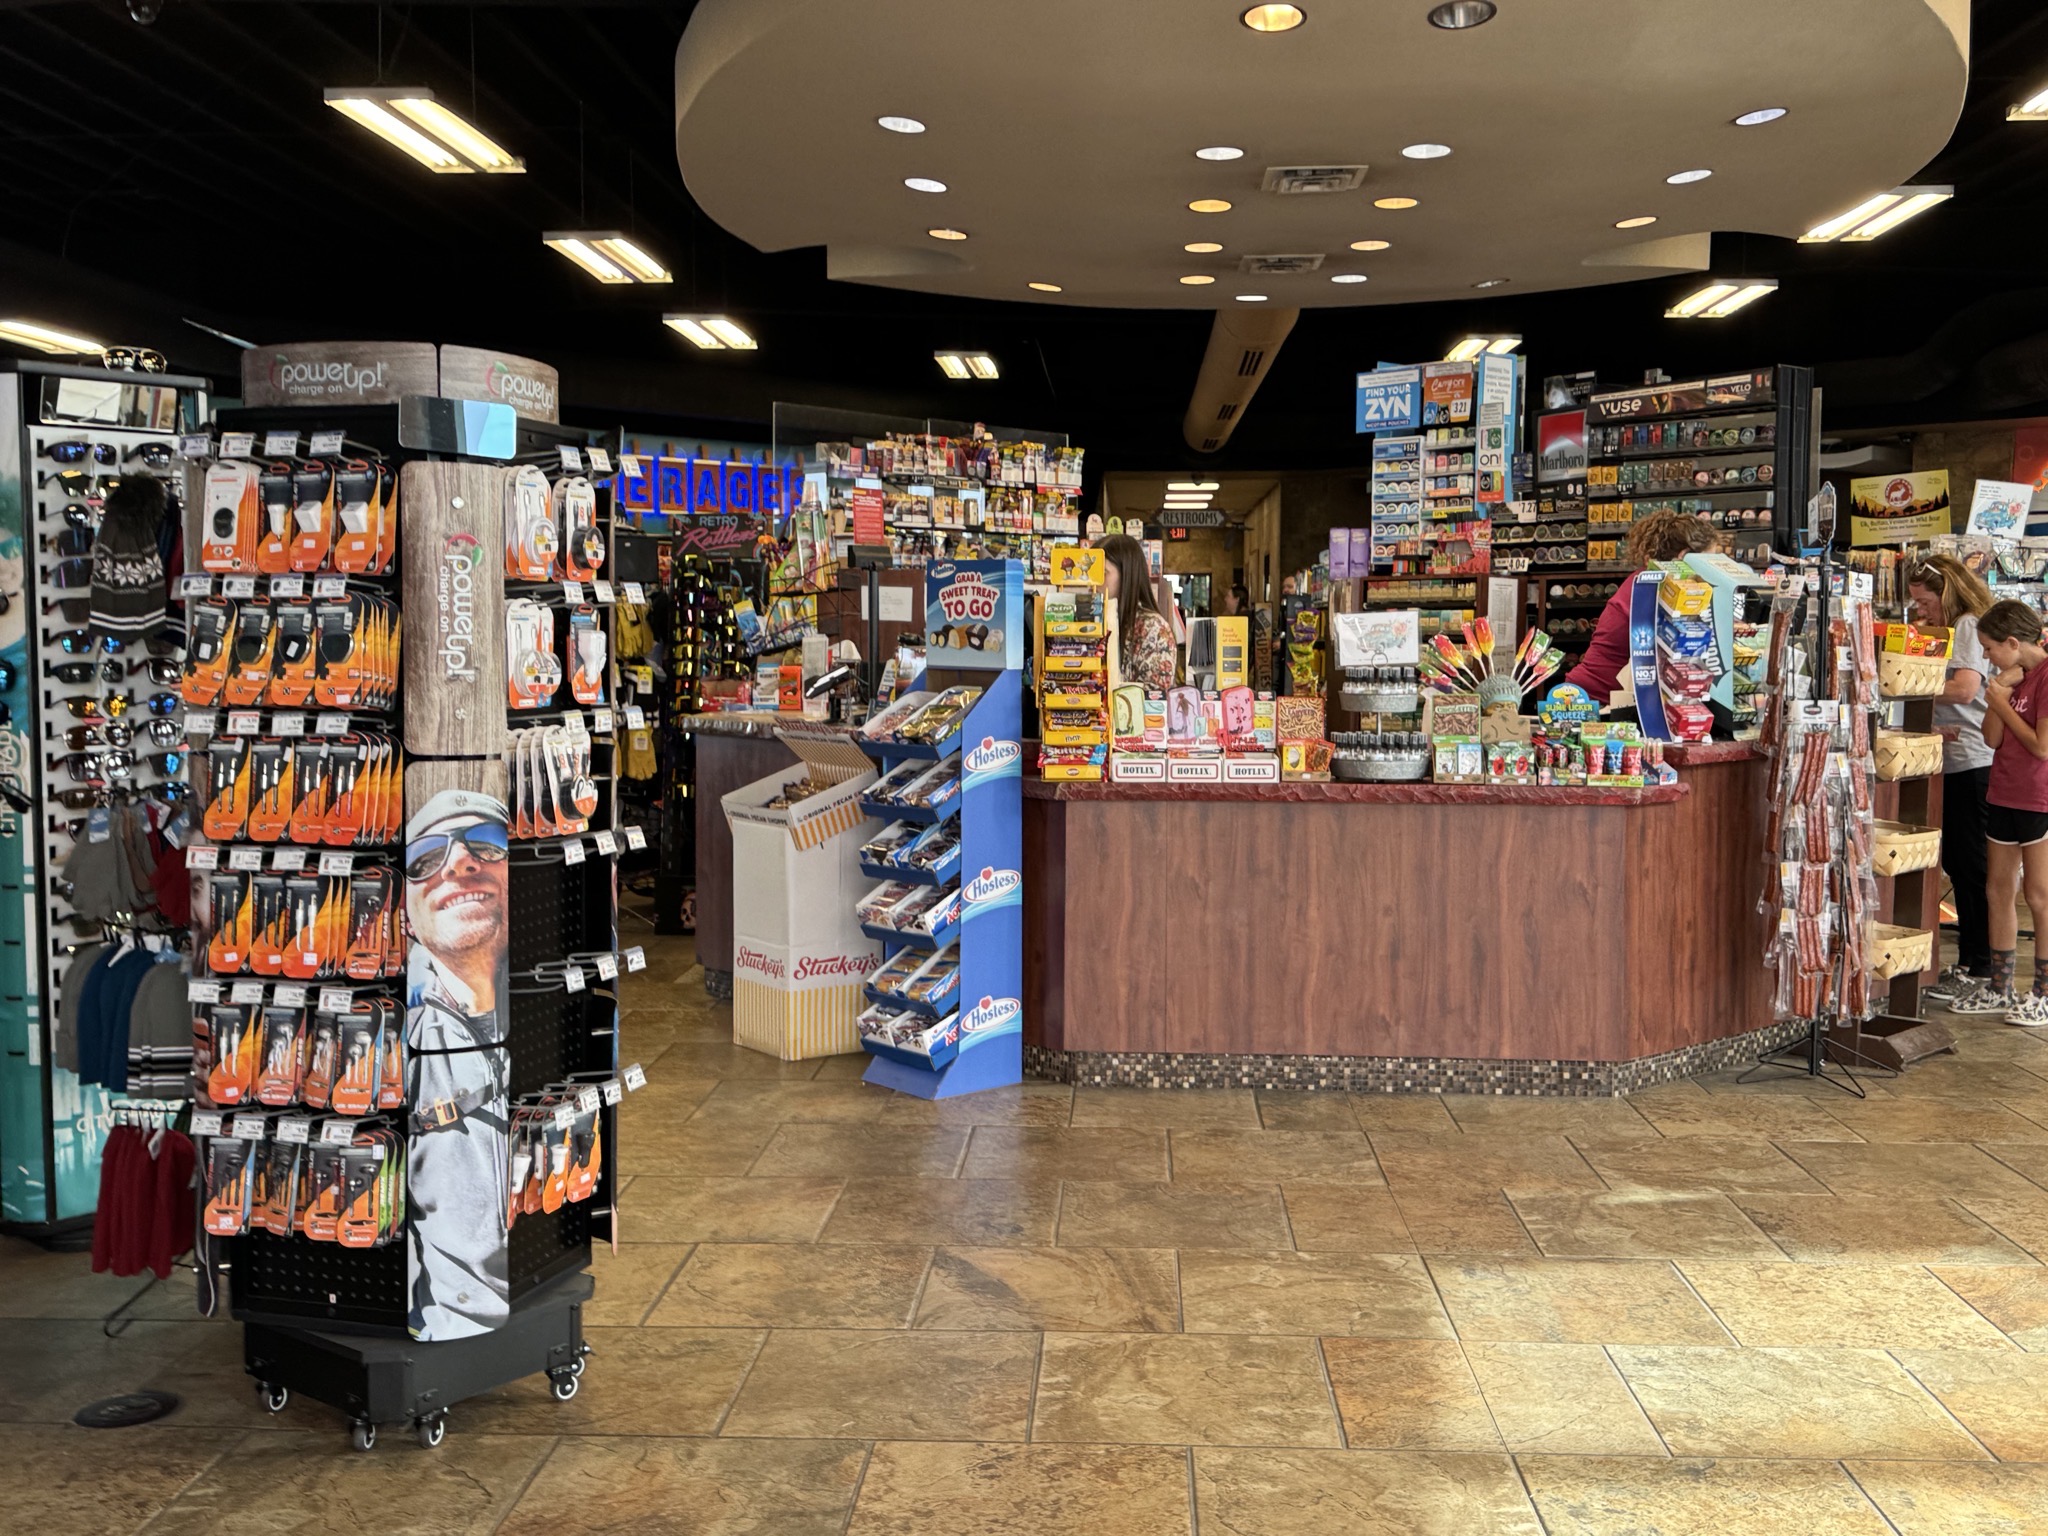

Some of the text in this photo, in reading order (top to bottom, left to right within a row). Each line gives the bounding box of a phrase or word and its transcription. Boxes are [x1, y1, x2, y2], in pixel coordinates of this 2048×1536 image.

[289, 383, 343, 396] charge on
[1365, 383, 1411, 399] FIND YOUR
[1730, 383, 1752, 393] VELO
[508, 396, 533, 409] charge
[1364, 393, 1412, 421] ZYN
[1540, 449, 1585, 472] Marlboro
[699, 515, 739, 527] RETRO
[1163, 511, 1218, 525] RESTROOMS
[956, 573, 981, 582] GRAB A
[438, 566, 450, 633] charge on
[941, 586, 998, 601] SWEET TREAT
[944, 599, 993, 618] TO GO
[1255, 628, 1272, 690] SUPPLIES
[1545, 703, 1593, 712] SLIME LICKER
[1552, 710, 1587, 721] SQUEEZE
[973, 744, 1016, 769] Hostess
[1047, 747, 1090, 756] Skittles
[1122, 766, 1155, 775] HOTLIX
[1177, 767, 1209, 776] HOTLIX
[1234, 767, 1268, 776] HOTLIX
[803, 804, 831, 821] ORIGINAL
[832, 794, 854, 809] PECAN
[750, 813, 767, 822] PECAN
[767, 816, 788, 826] SHOPPE
[973, 874, 1016, 899] Hostess
[736, 945, 786, 979] Stuckey's
[793, 952, 880, 980] Stuckey's
[971, 1003, 1015, 1029] Hostess
